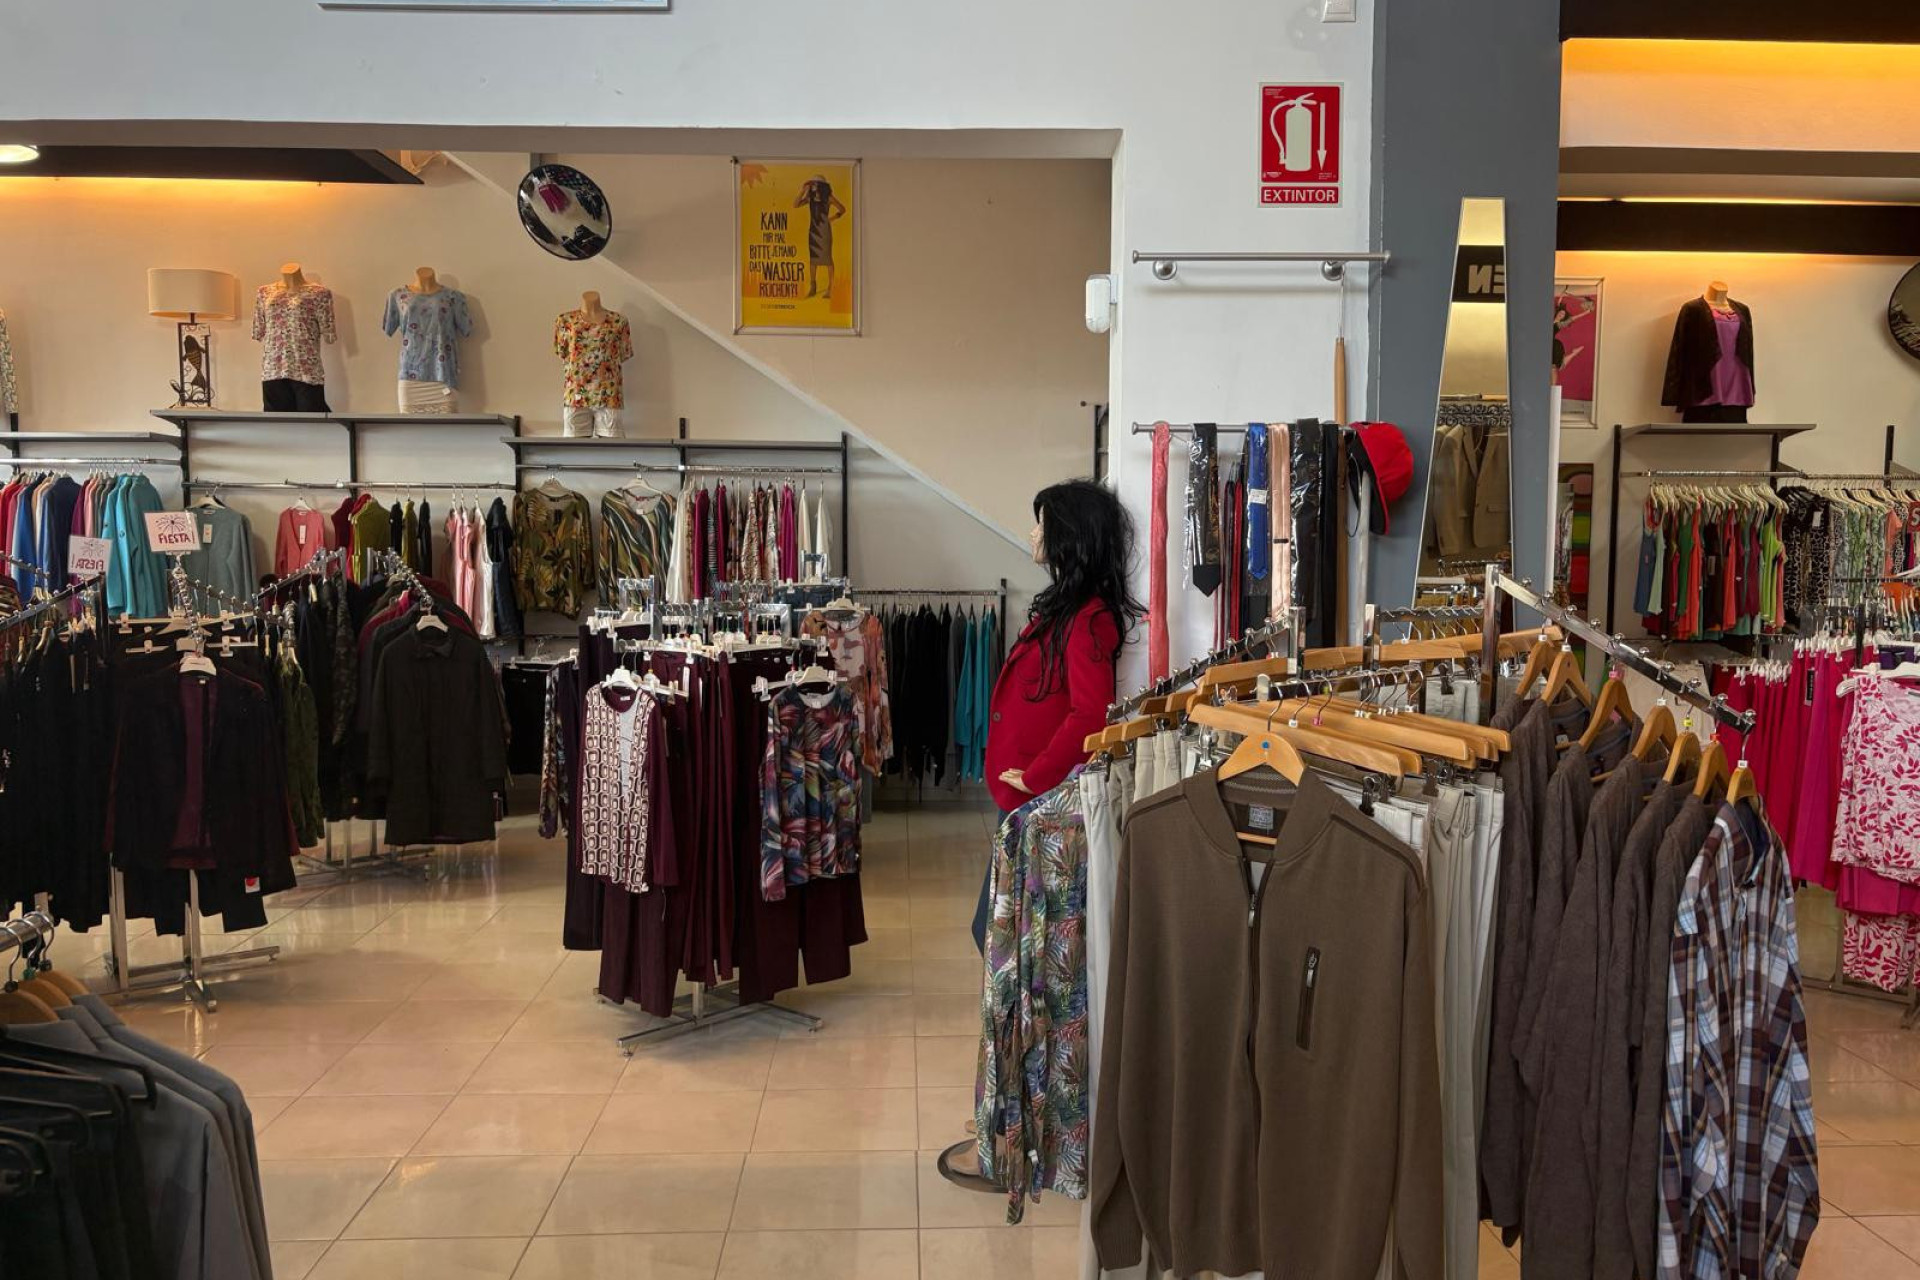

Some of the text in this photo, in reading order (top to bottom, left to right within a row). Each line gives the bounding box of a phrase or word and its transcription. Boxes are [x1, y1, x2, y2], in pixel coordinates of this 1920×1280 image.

[1263, 189, 1336, 202] EXTINTOR
[760, 211, 788, 231] KANN
[749, 245, 797, 260] BITTE JEMAND
[749, 261, 805, 281] DAS WASSER
